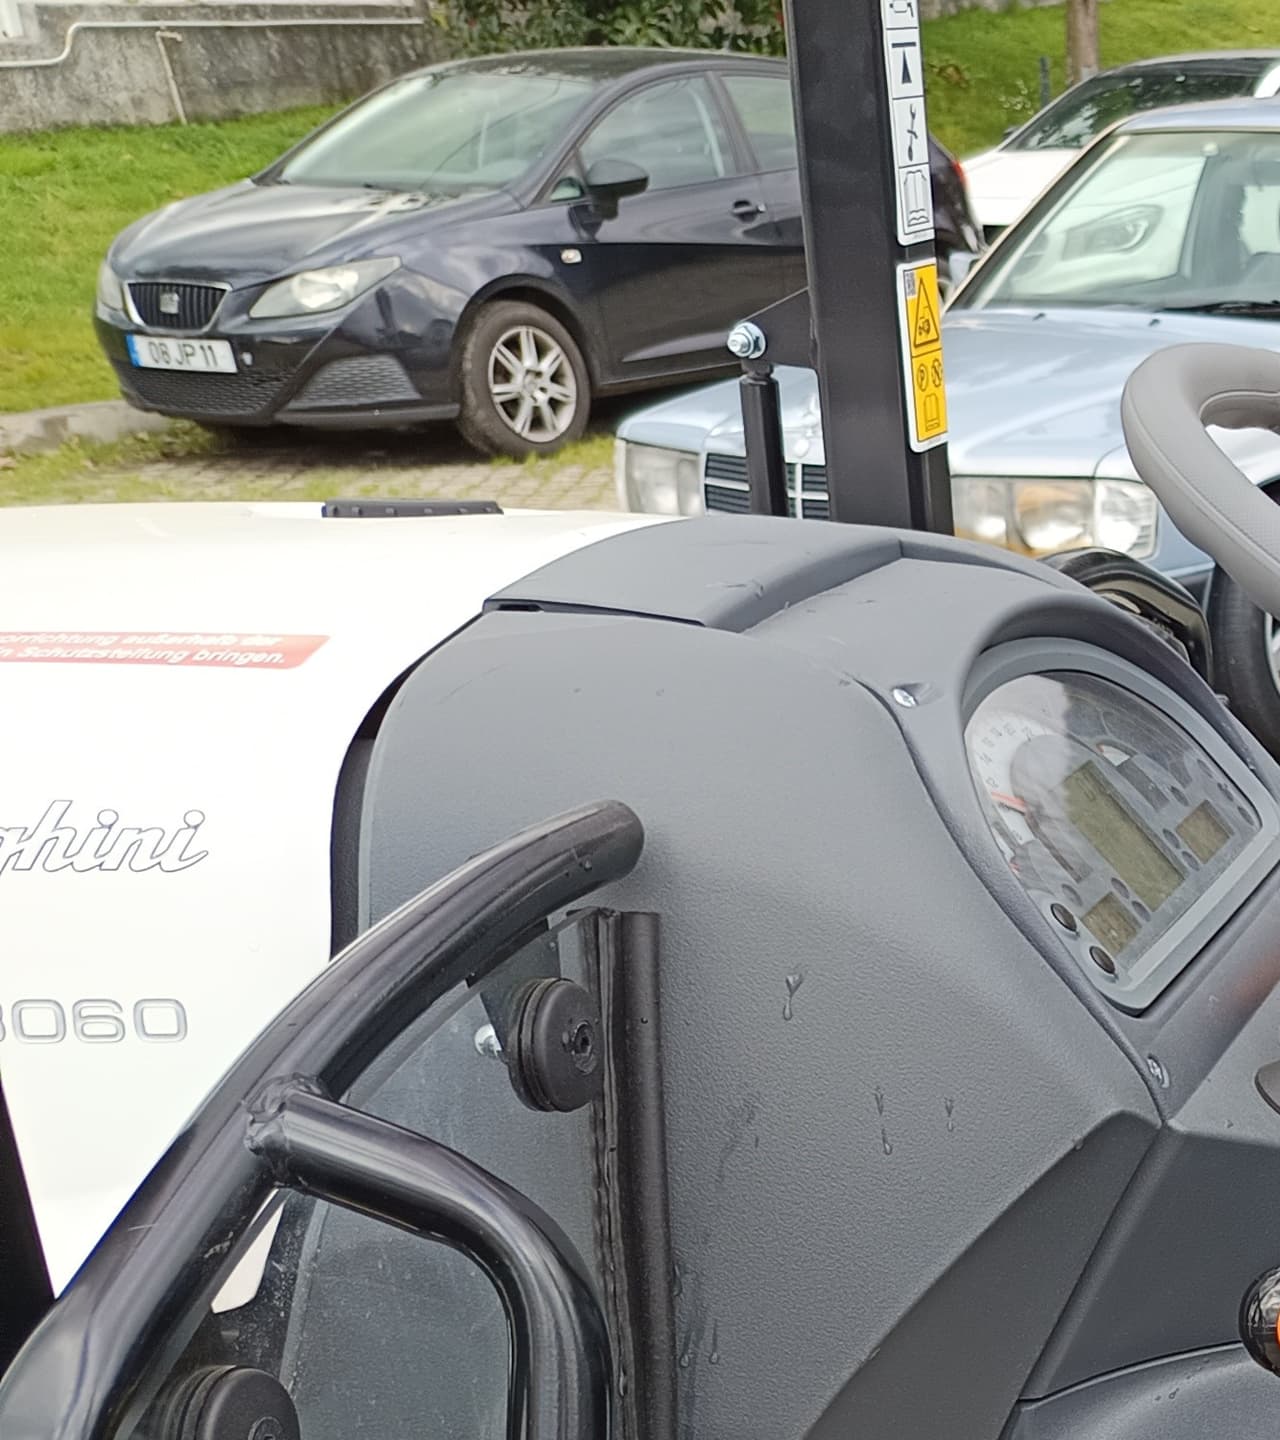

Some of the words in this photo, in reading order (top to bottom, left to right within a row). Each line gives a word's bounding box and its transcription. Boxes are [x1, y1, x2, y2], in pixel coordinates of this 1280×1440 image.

[176, 343, 196, 367] JP
[199, 345, 218, 368] 11
[192, 649, 286, 665] bringen.
[0, 998, 188, 1044] 060
